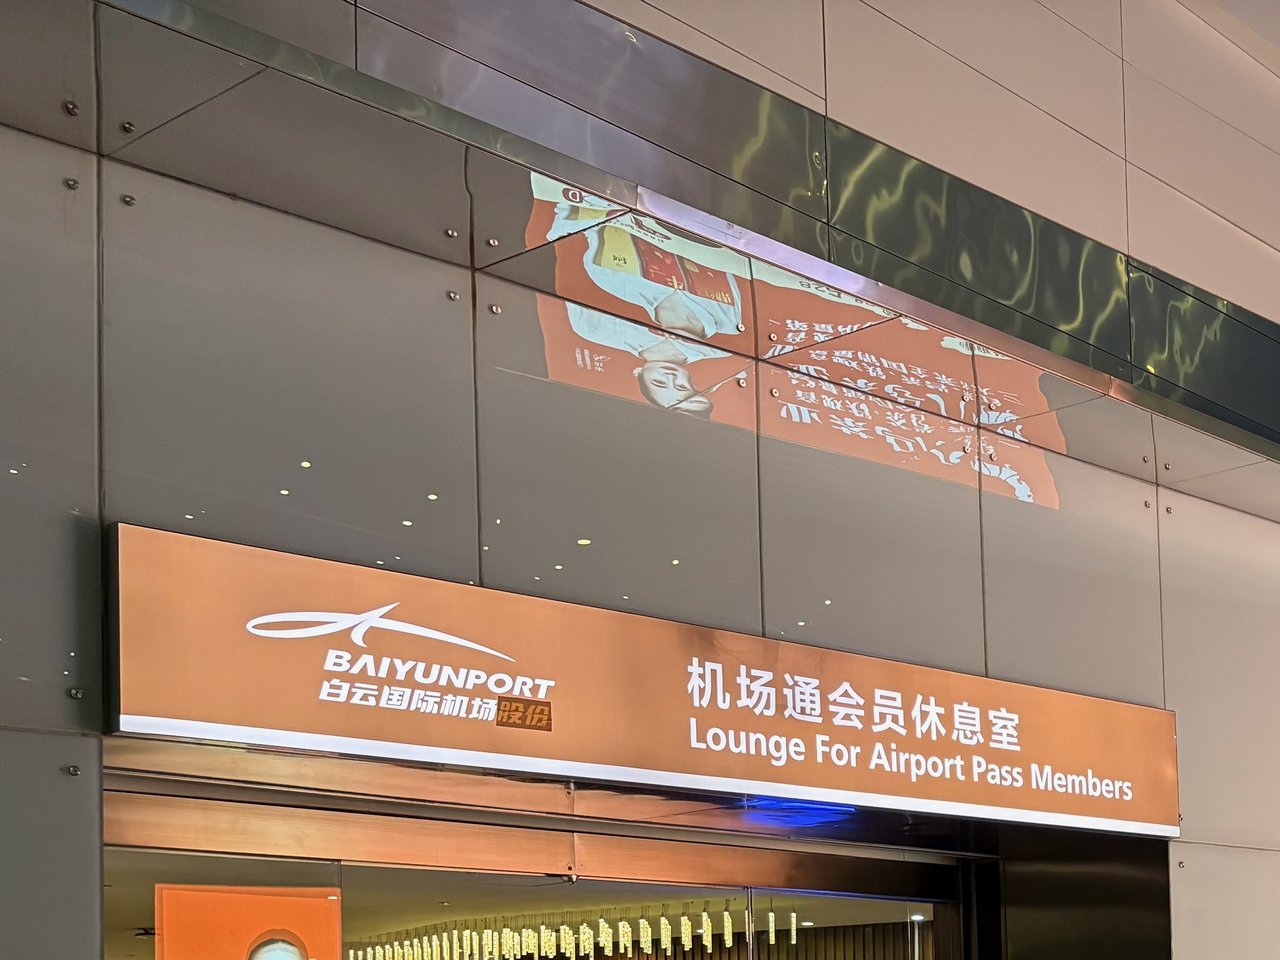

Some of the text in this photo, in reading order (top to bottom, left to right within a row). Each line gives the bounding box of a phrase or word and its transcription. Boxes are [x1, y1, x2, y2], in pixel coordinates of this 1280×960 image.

[323, 649, 556, 699] BAIYUNPORT
[686, 656, 1021, 752] 机场通会员休息室
[689, 717, 1133, 801] Lounge For Airport Pass Members
